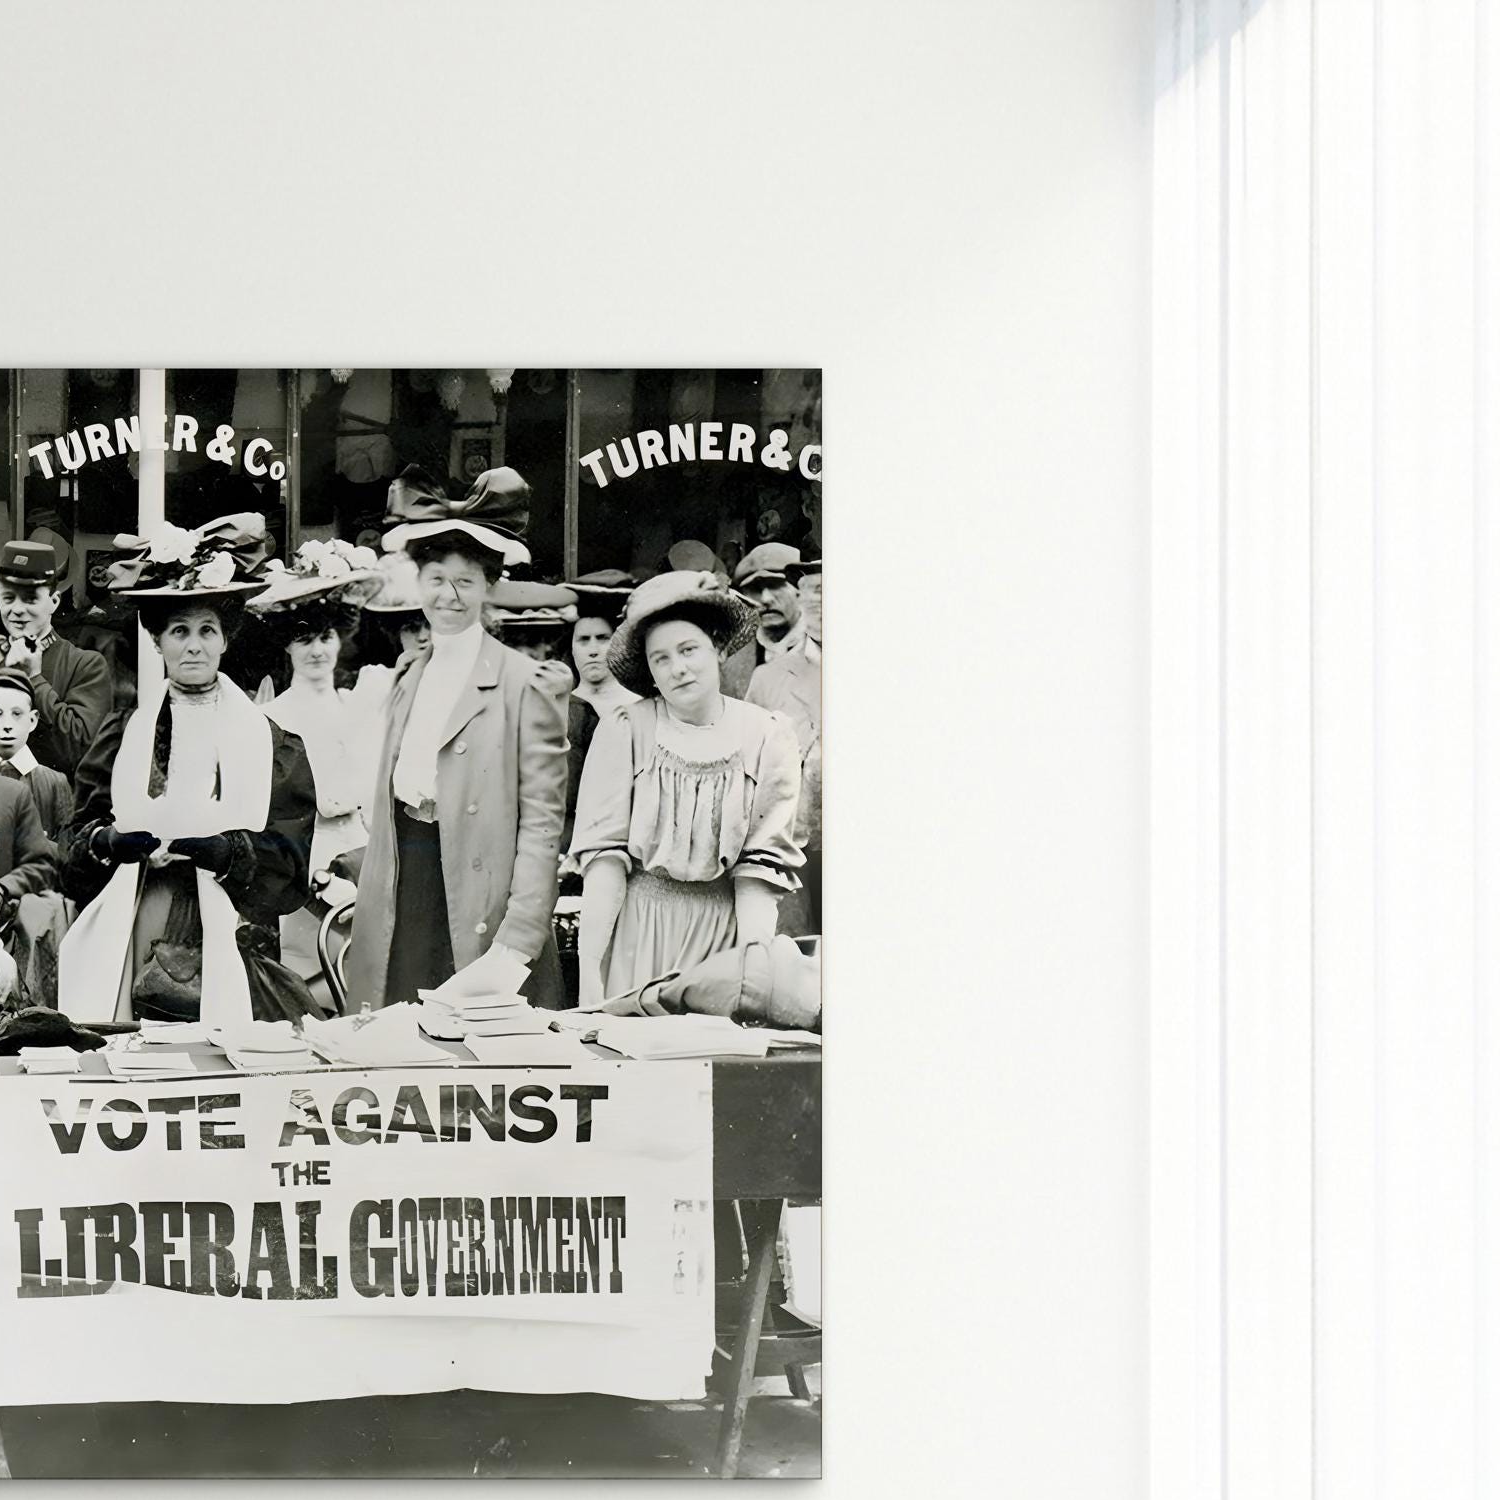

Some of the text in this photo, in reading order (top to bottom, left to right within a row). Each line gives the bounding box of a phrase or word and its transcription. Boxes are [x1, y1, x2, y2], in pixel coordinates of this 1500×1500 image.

[28, 414, 199, 480] TURNR
[579, 422, 757, 489] TURNER
[40, 1084, 609, 1154] VOTE AGAINST
[270, 1160, 331, 1187] THE
[14, 1199, 339, 1300] LIBERAL
[349, 1196, 627, 1299] GOVERNMENT
